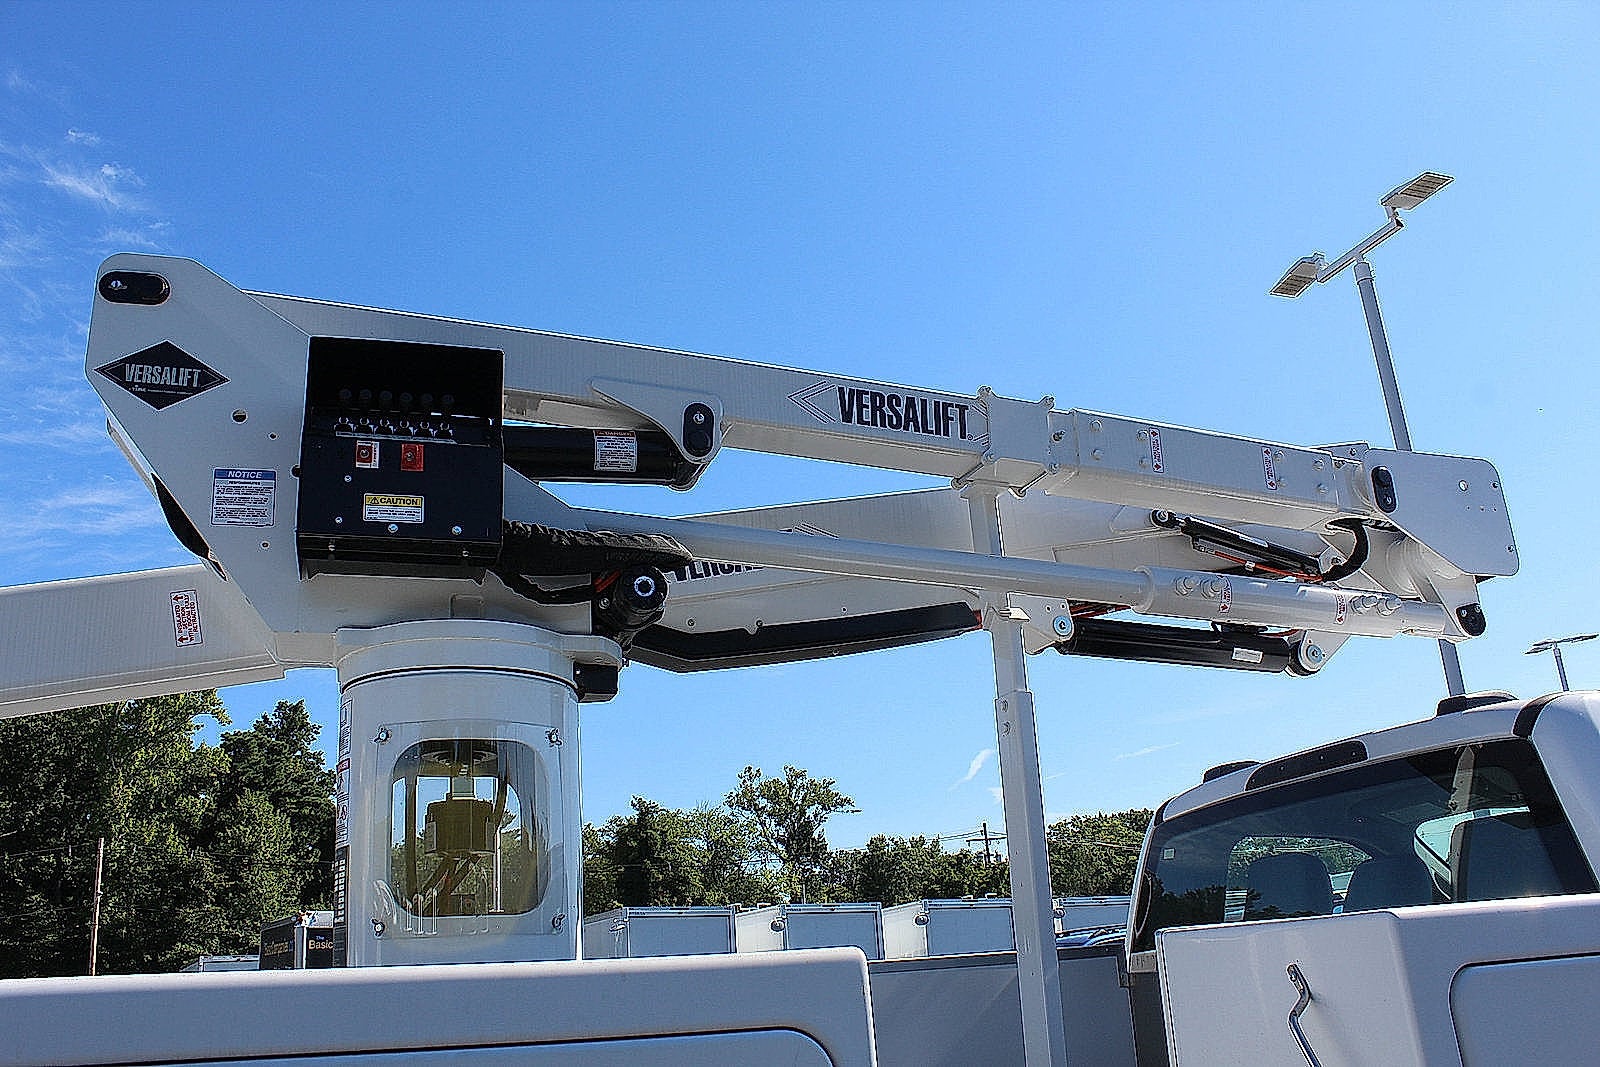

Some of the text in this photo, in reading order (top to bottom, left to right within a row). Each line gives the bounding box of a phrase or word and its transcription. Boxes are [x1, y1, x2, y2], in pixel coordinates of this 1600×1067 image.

[125, 363, 202, 388] VERSALIFT
[837, 386, 969, 440] VERSALIFT
[227, 471, 263, 479] NOTICE
[379, 497, 418, 506] CAUTION
[308, 939, 334, 950] Basic
